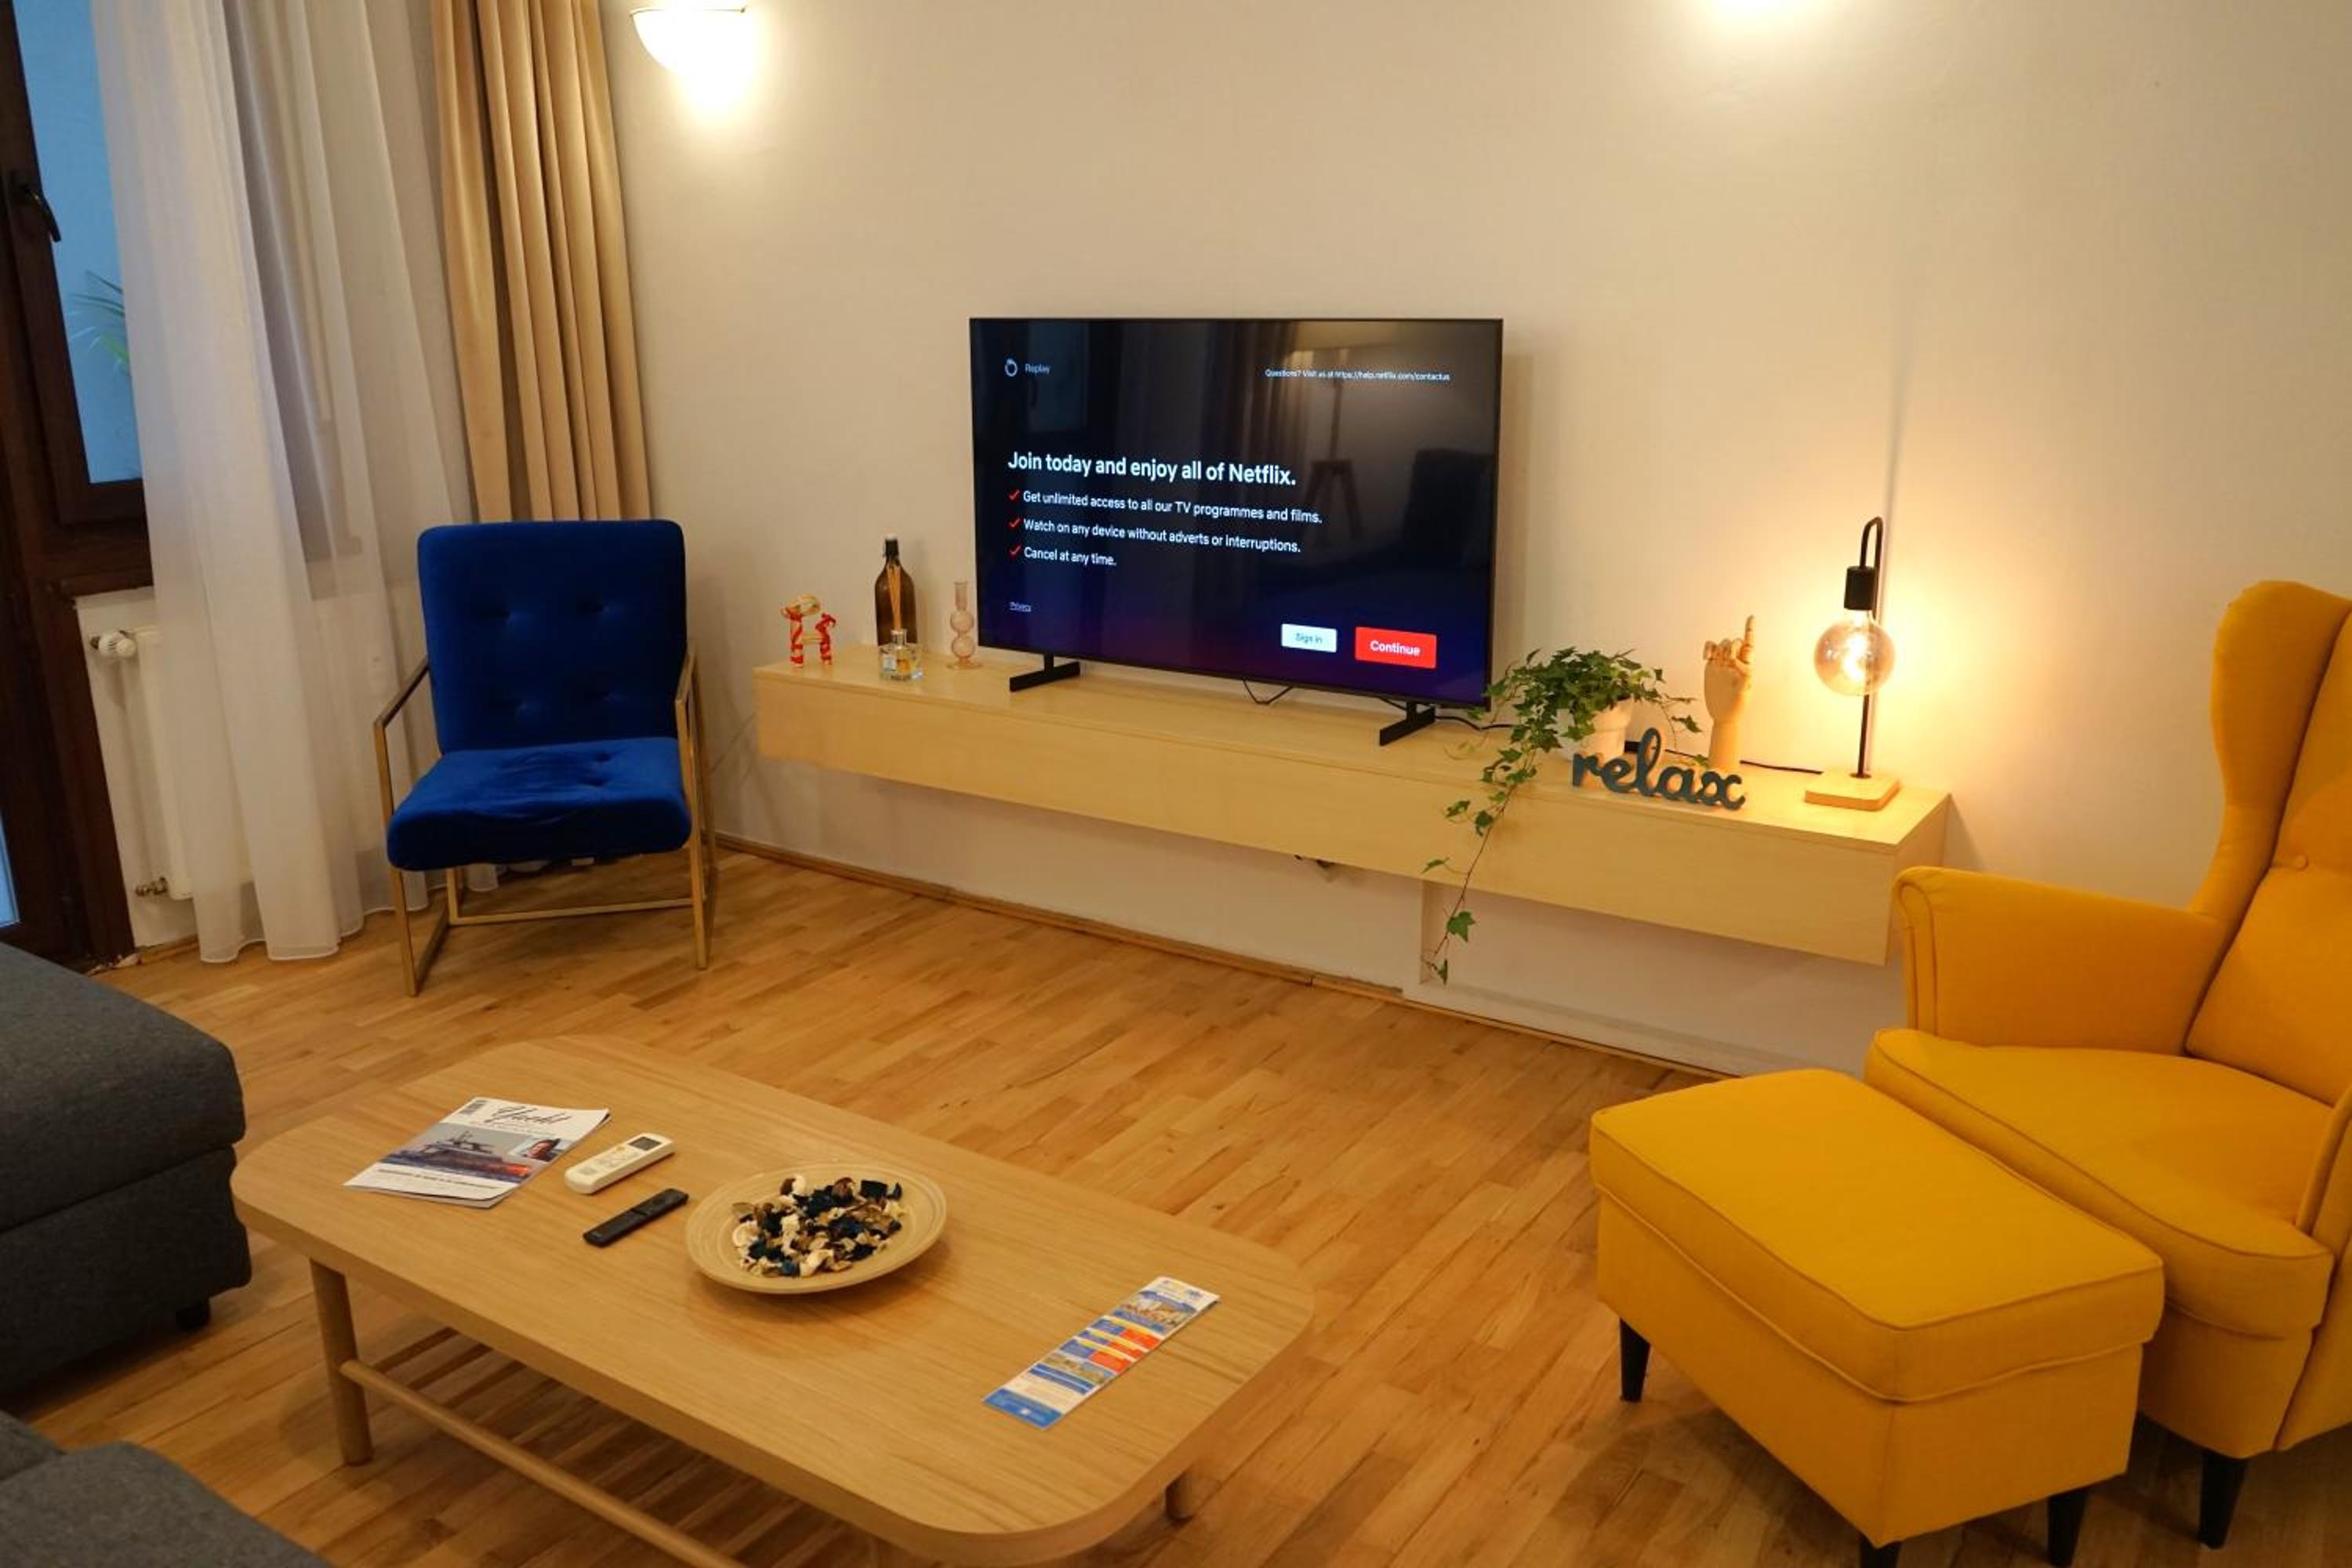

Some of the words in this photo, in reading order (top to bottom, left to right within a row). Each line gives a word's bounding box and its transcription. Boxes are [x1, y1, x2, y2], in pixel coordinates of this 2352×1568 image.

[1007, 451, 1042, 470] Join
[1045, 453, 1092, 477] today
[1095, 457, 1127, 476] and
[1130, 459, 1178, 482] enjoy
[1181, 460, 1202, 480] all
[1205, 463, 1225, 481] of
[1229, 463, 1296, 485] Netflix.
[1023, 490, 1041, 503] Get
[1042, 492, 1088, 506] unlimited
[1091, 497, 1126, 509] access
[1127, 499, 1139, 510] to
[1141, 499, 1153, 510] all
[1155, 501, 1172, 512] our
[1175, 501, 1191, 514] TV
[1193, 504, 1264, 518] programmes
[1266, 508, 1288, 521] and
[1290, 509, 1323, 523] films.
[1023, 518, 1055, 532] Watch
[1058, 523, 1070, 533] on
[1072, 524, 1091, 538] any
[1091, 523, 1126, 539] device
[1127, 528, 1167, 541] without
[1169, 531, 1210, 545] adverts
[1211, 535, 1224, 546] or
[1225, 535, 1301, 553] interruptions.
[1023, 546, 1058, 561] Cancel
[1059, 550, 1069, 561] at
[1071, 552, 1089, 566] any
[1091, 553, 1117, 566] time.
[1295, 633, 1314, 644] Sign
[1370, 641, 1421, 656] Continue
[1572, 727, 1747, 811] relax
